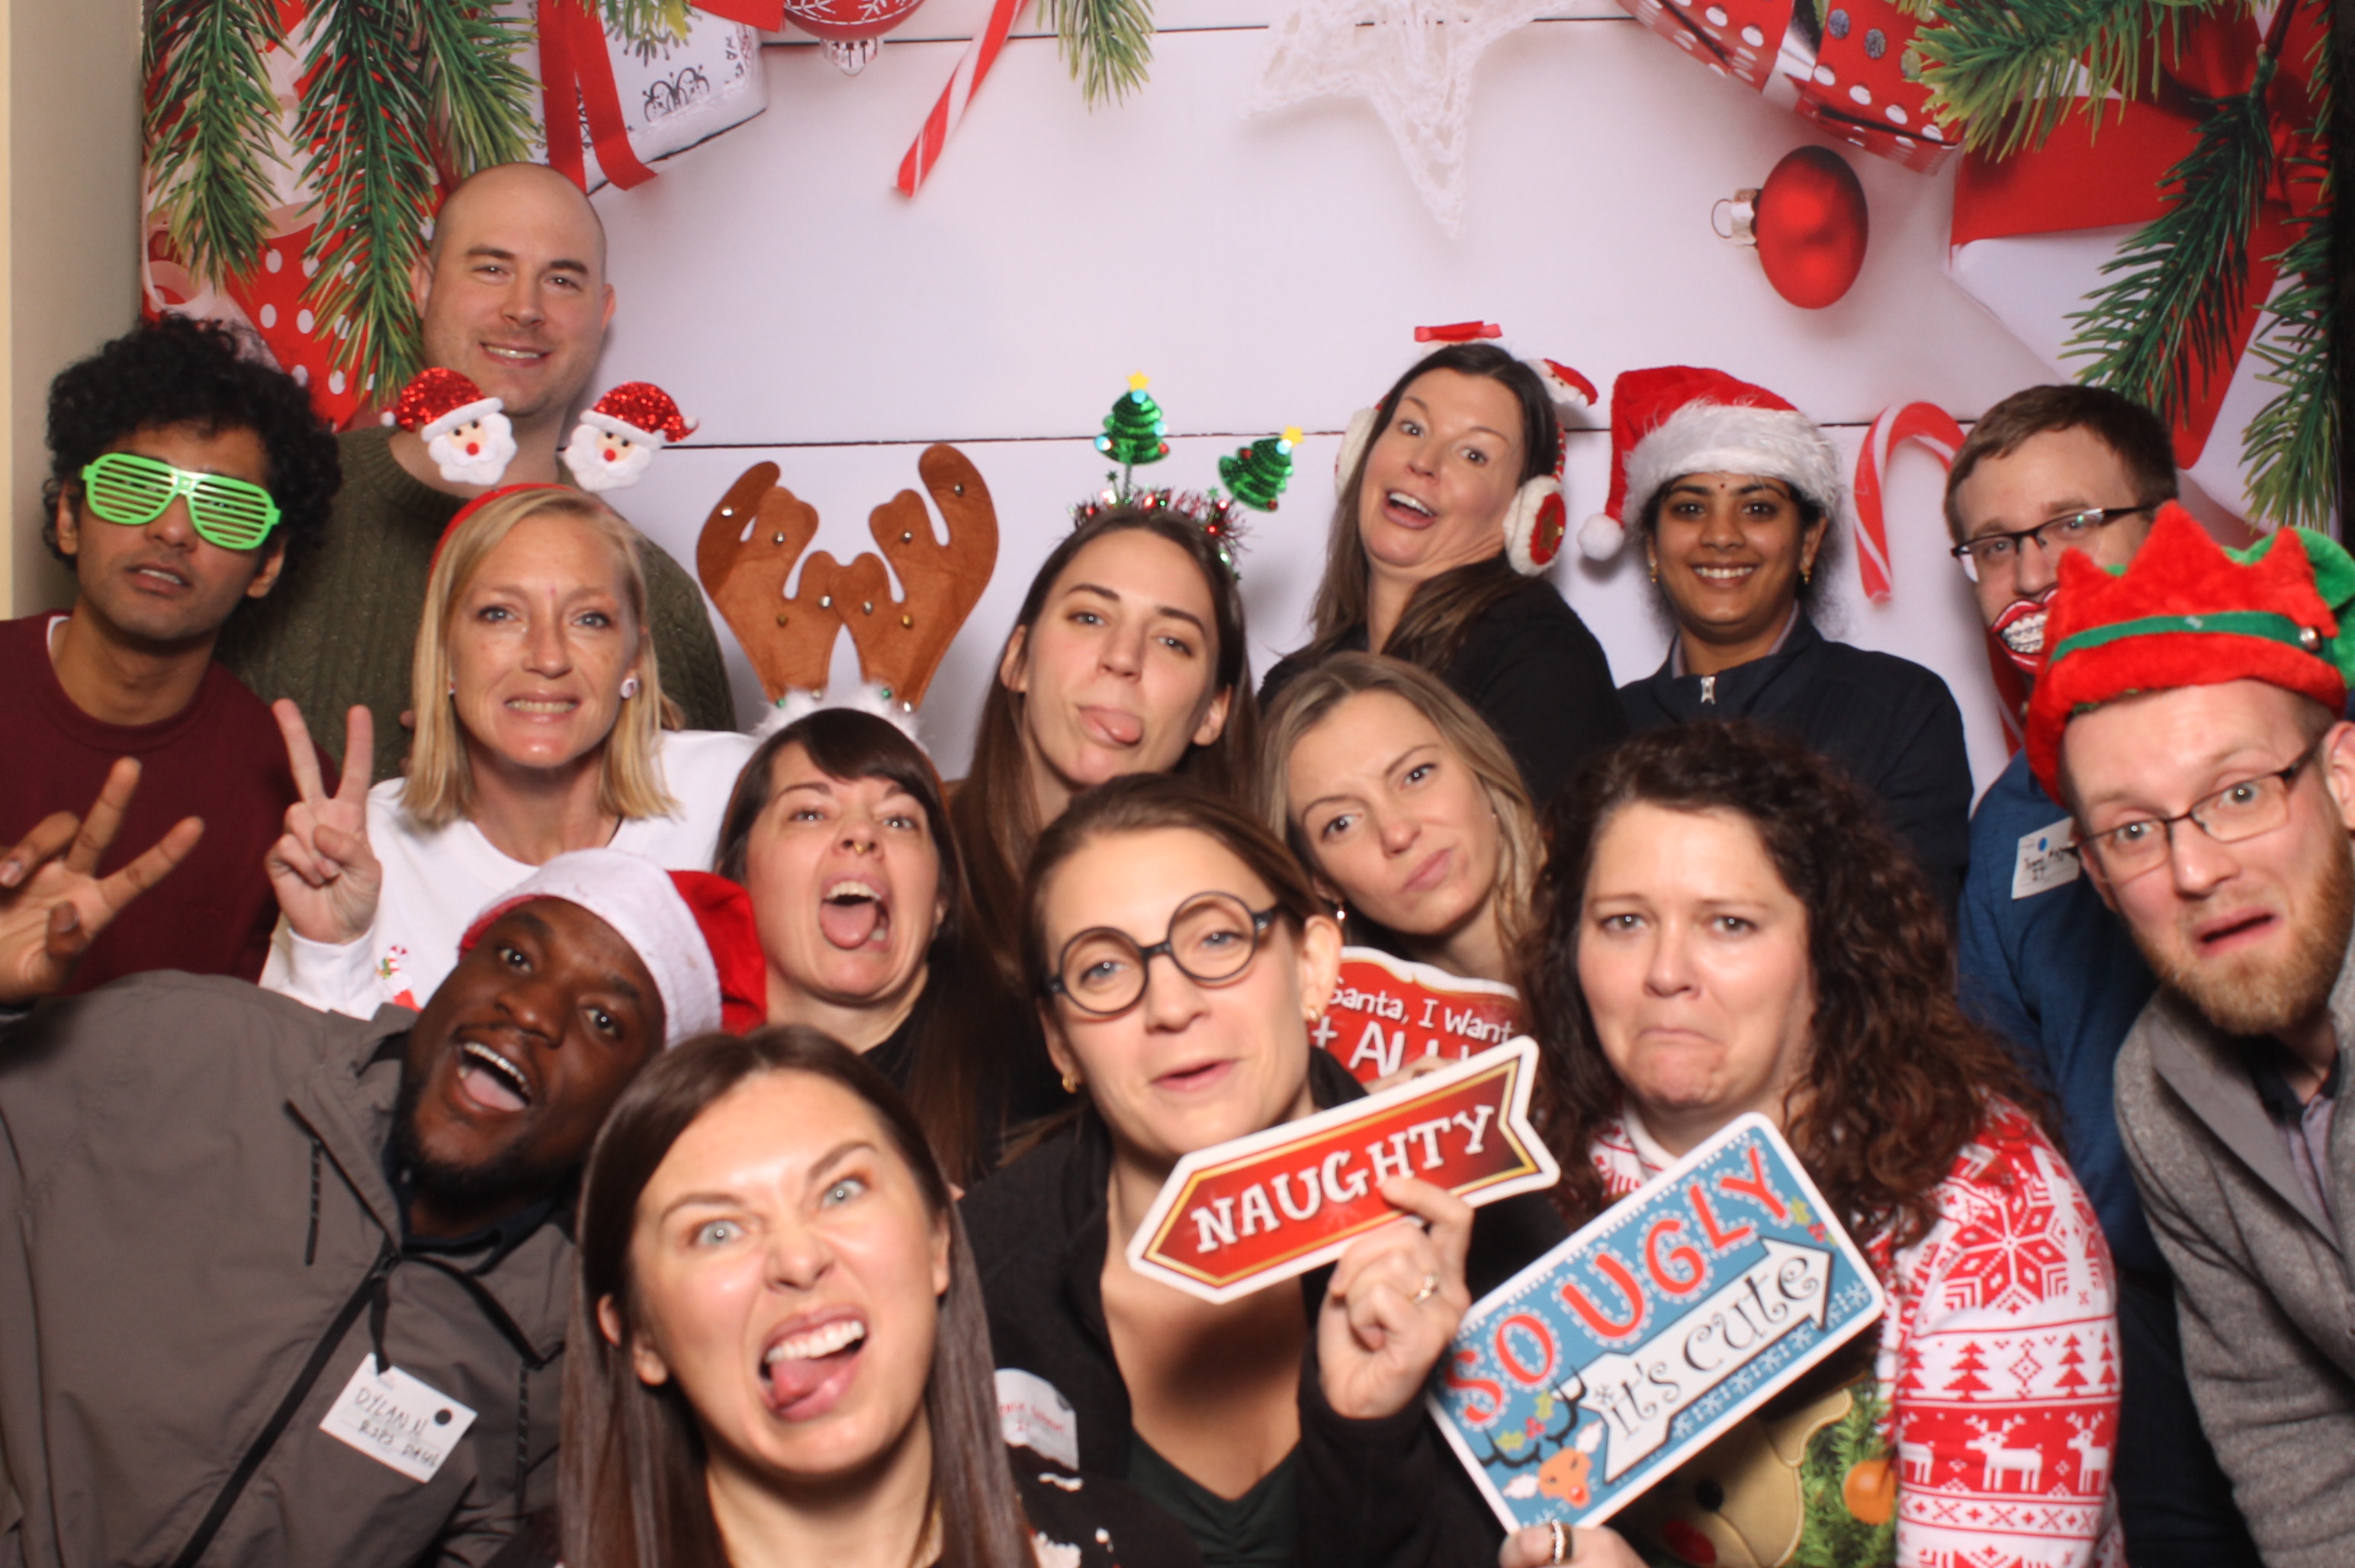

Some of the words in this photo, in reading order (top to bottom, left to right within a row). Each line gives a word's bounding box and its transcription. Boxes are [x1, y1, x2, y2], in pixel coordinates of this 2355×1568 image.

[1417, 998, 1440, 1029] I
[1443, 1007, 1515, 1044] Want
[1190, 1104, 1496, 1255] NAUGHTY
[1445, 1313, 1555, 1425] SO
[1560, 1146, 1787, 1338] UGLY
[354, 1386, 410, 1431] DYLAN
